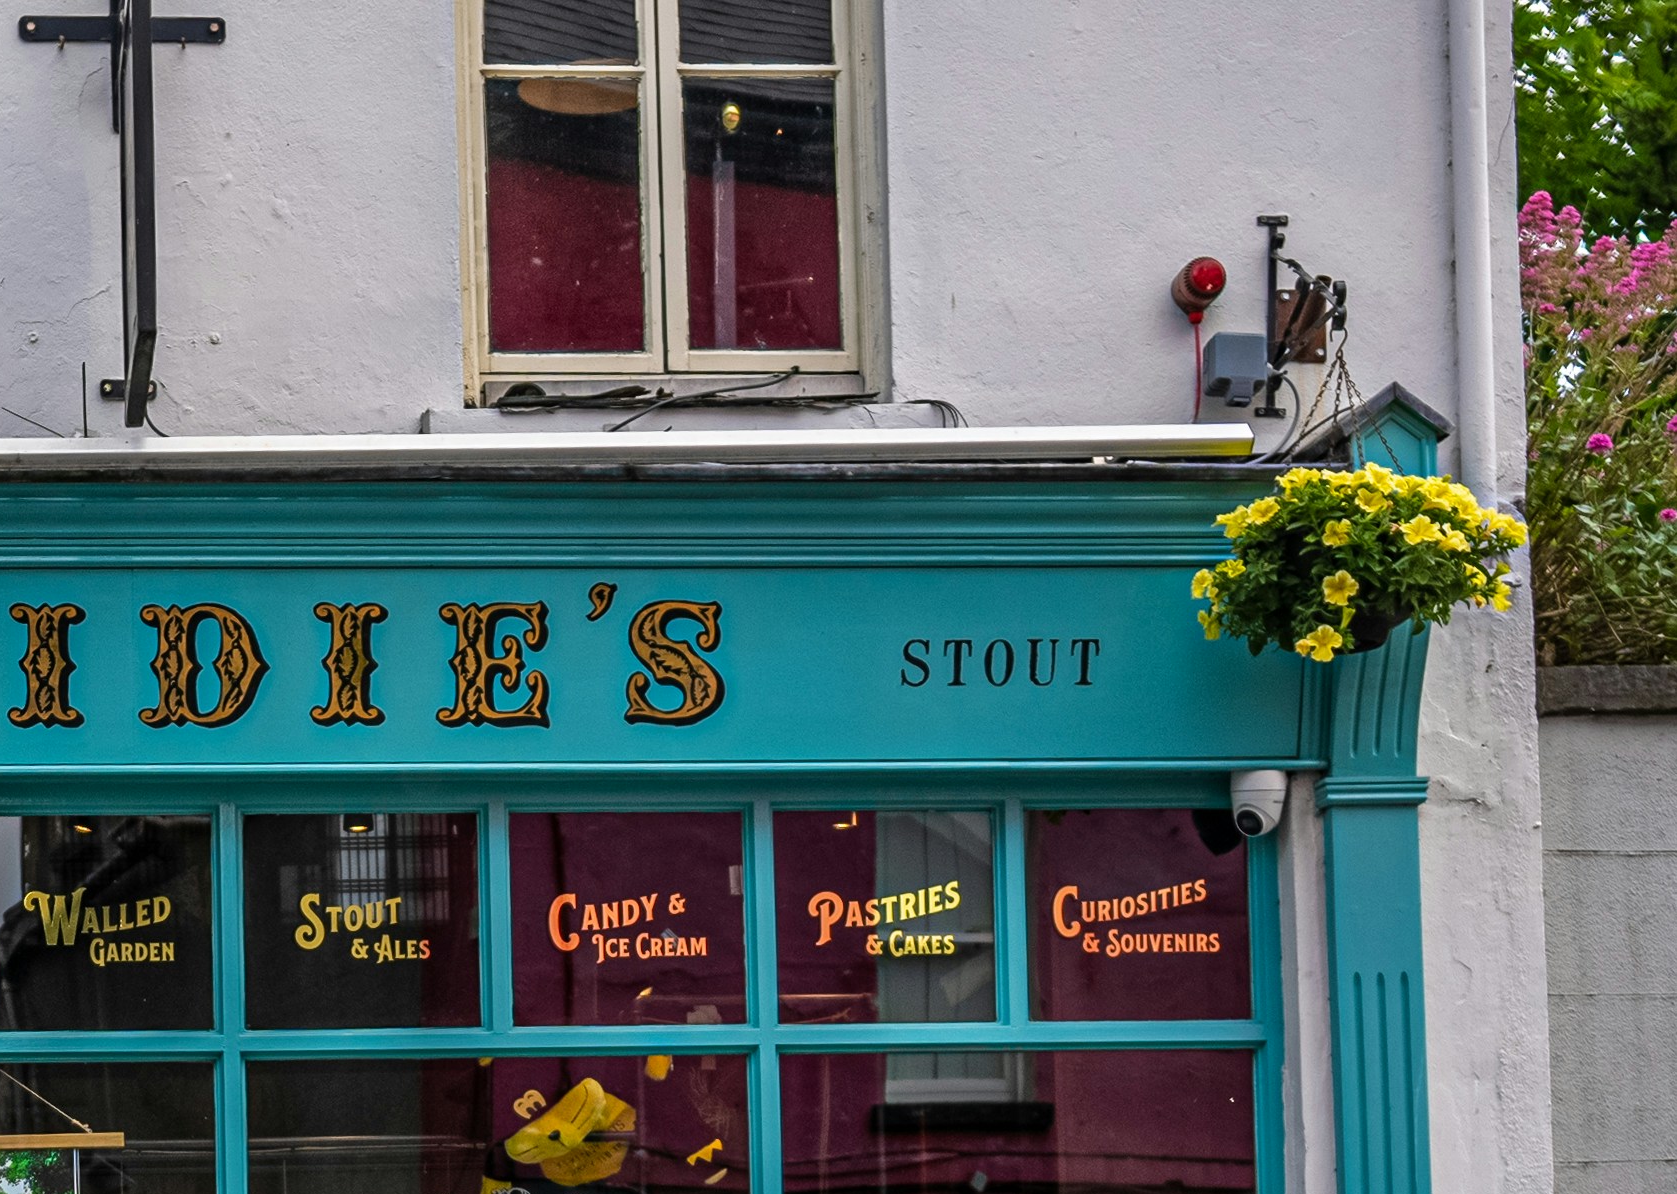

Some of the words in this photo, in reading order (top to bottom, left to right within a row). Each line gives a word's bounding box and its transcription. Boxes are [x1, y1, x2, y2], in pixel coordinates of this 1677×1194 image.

[899, 638, 1101, 688] STOUT
[24, 886, 171, 947] WALLED
[295, 893, 401, 950] STOUT
[548, 893, 658, 951] CANDY
[668, 892, 686, 915] &
[808, 880, 961, 946] PASTRIES
[1052, 879, 1207, 938] CURIOSITIES
[89, 938, 175, 967] GARDEN
[351, 938, 369, 960] &
[374, 934, 431, 963] ALES
[591, 933, 630, 964] ICE
[635, 932, 708, 960] CREAM
[865, 933, 883, 955] &
[889, 930, 955, 958] CAKES
[1082, 933, 1100, 954] &
[1105, 928, 1221, 957] SOUVENIRS
